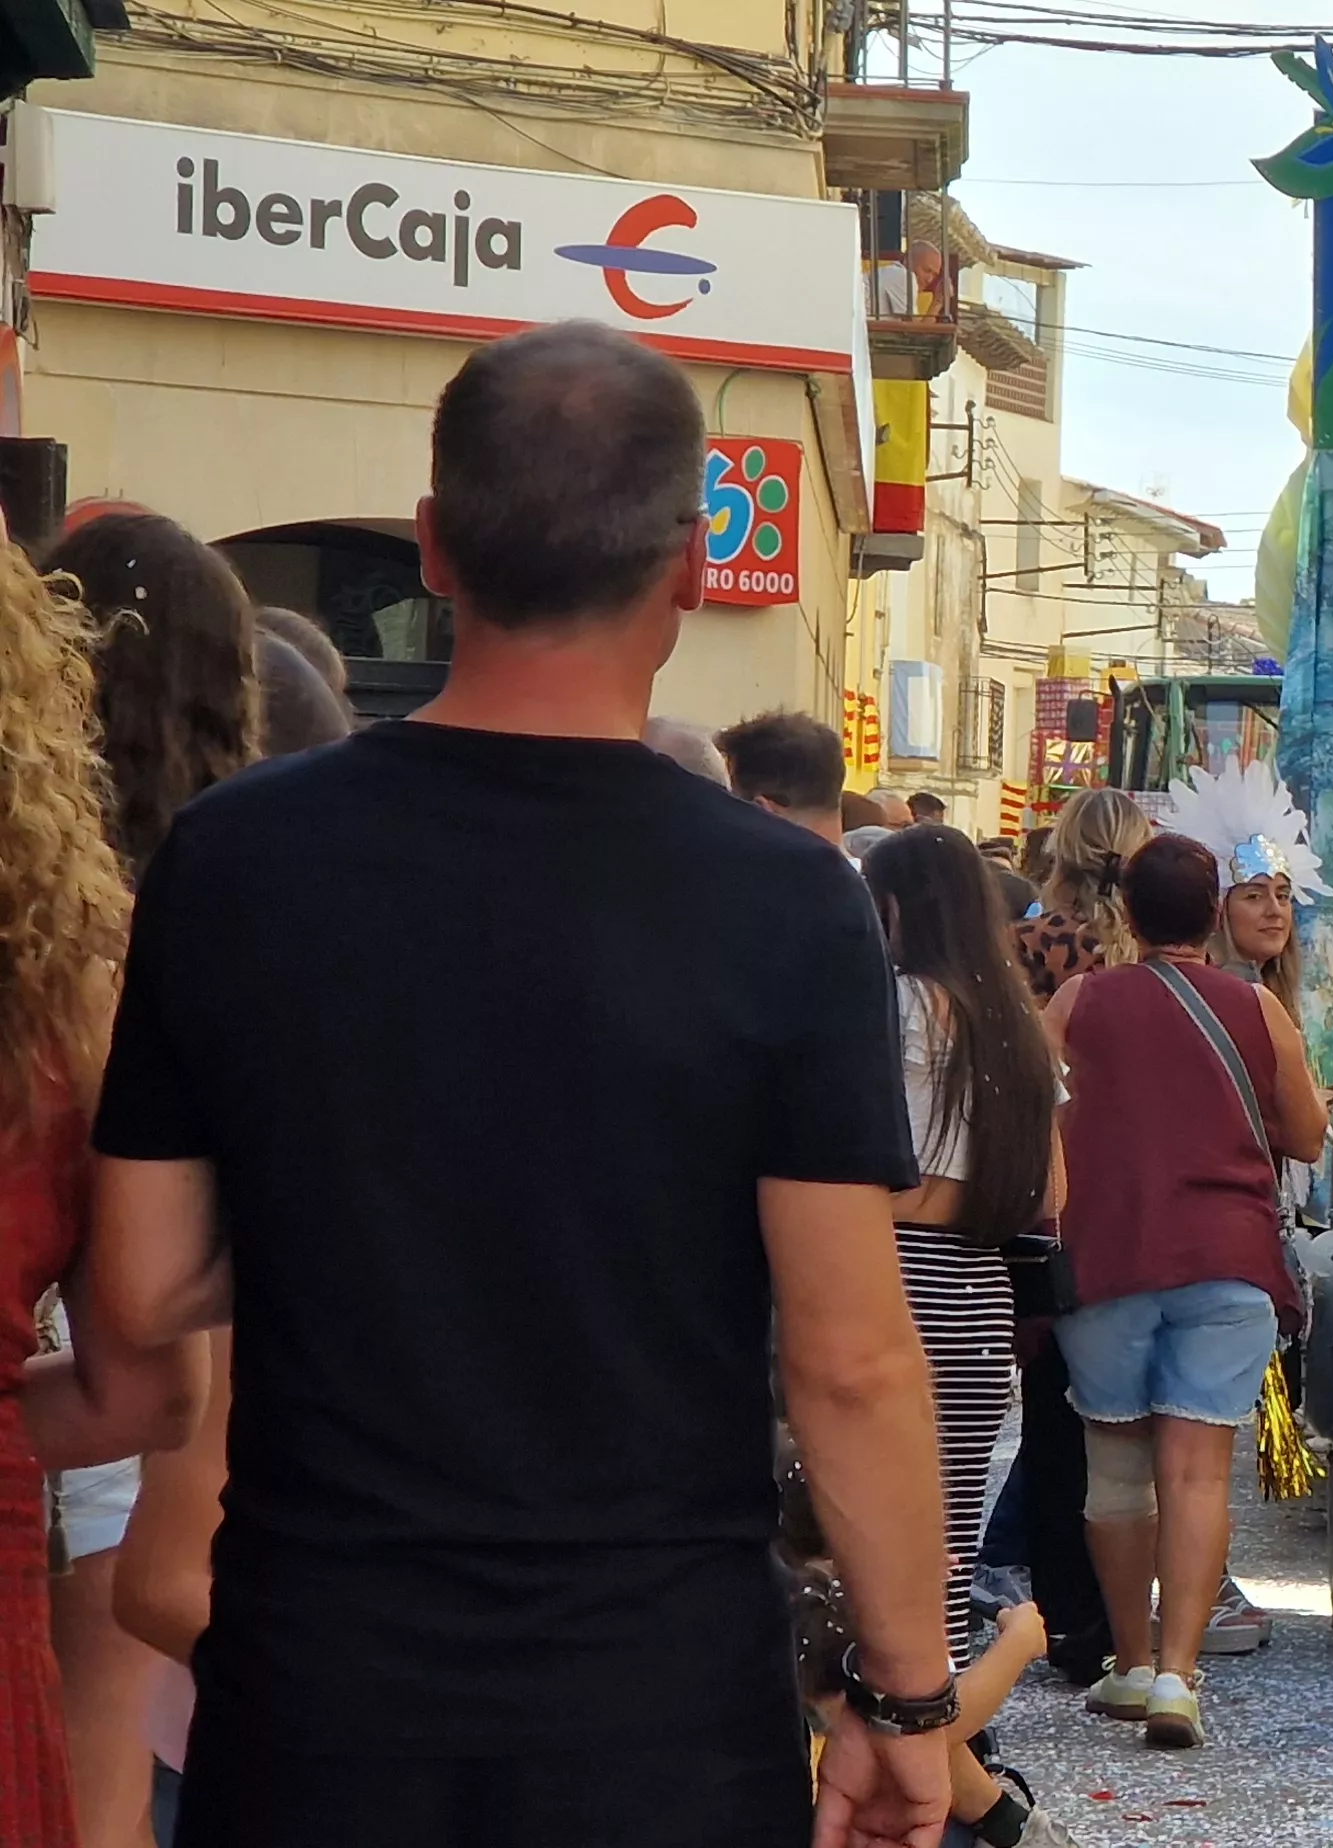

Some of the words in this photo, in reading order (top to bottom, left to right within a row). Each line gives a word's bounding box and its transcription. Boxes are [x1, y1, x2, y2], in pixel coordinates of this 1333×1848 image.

[176, 157, 523, 288] iberCaja
[706, 568, 734, 590] RO
[738, 569, 794, 595] 6000
